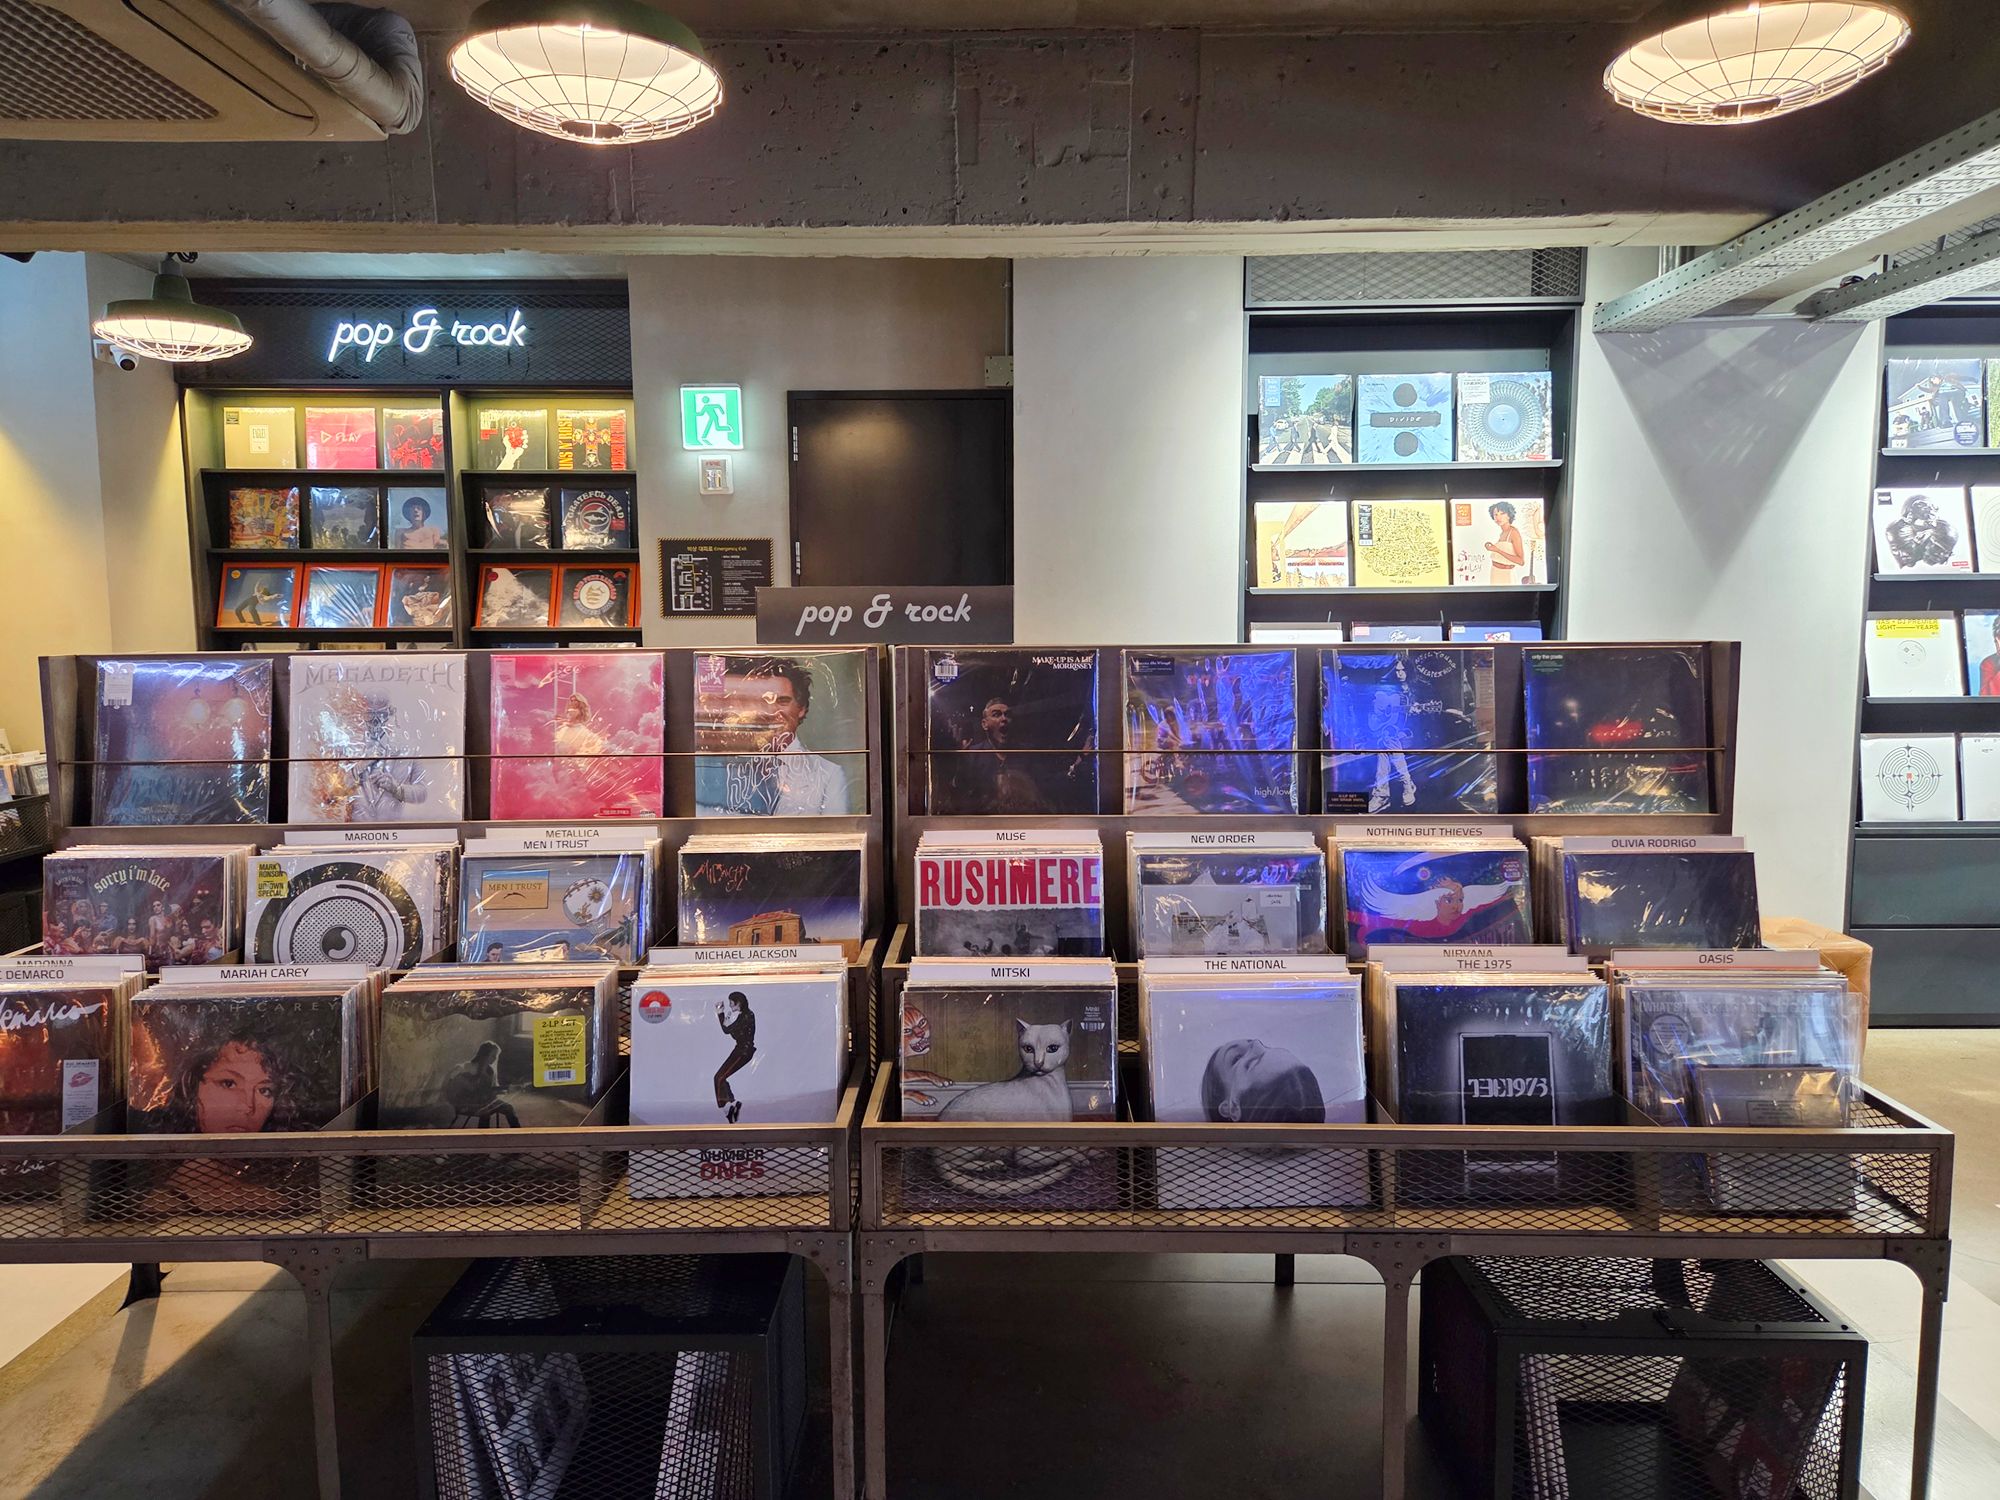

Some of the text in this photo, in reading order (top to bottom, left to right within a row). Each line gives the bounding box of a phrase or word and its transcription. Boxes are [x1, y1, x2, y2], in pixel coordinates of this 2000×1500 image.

[327, 308, 527, 363] pop & rock
[1389, 415, 1422, 424] DIVIDE
[335, 431, 361, 443] PLAY
[606, 494, 625, 519] DEAD
[795, 593, 972, 636] pop & rock
[1032, 656, 1067, 665] MAKE-UP
[1053, 662, 1093, 671] MORRISSEY
[298, 662, 456, 693] MEGADETH
[1254, 786, 1291, 799] high/low
[344, 831, 399, 842] MAROON 5
[545, 829, 600, 838] METALLICA
[996, 831, 1026, 842] MUSE
[1366, 827, 1483, 837] NOTHING BUT THIEVES
[523, 839, 590, 850] MEN I TRUST
[1191, 834, 1255, 845] NEW ORDER
[1610, 838, 1697, 849] OLIVIA RODRIGO
[259, 863, 277, 871] MARK
[94, 869, 128, 893] sorry
[128, 864, 148, 882] i'm
[147, 869, 171, 892] late
[919, 857, 1101, 907] RUSHMERE
[488, 883, 509, 892] MEN
[515, 882, 543, 891] TRUST
[694, 948, 798, 962] MICHAEL JACKSON
[1443, 948, 1494, 958] NIRVANA
[1698, 953, 1734, 964] OASIS
[1204, 958, 1287, 970] THE NATIONAL
[1457, 959, 1512, 970] THE 1975
[5, 969, 64, 980] DEMARCO
[220, 967, 310, 980] MARIAH CAREY
[990, 966, 1031, 978] MITSKI
[136, 1001, 340, 1016] MARIAH CAREY
[700, 1149, 765, 1162] NUMBER
[700, 1160, 766, 1180] ONES
